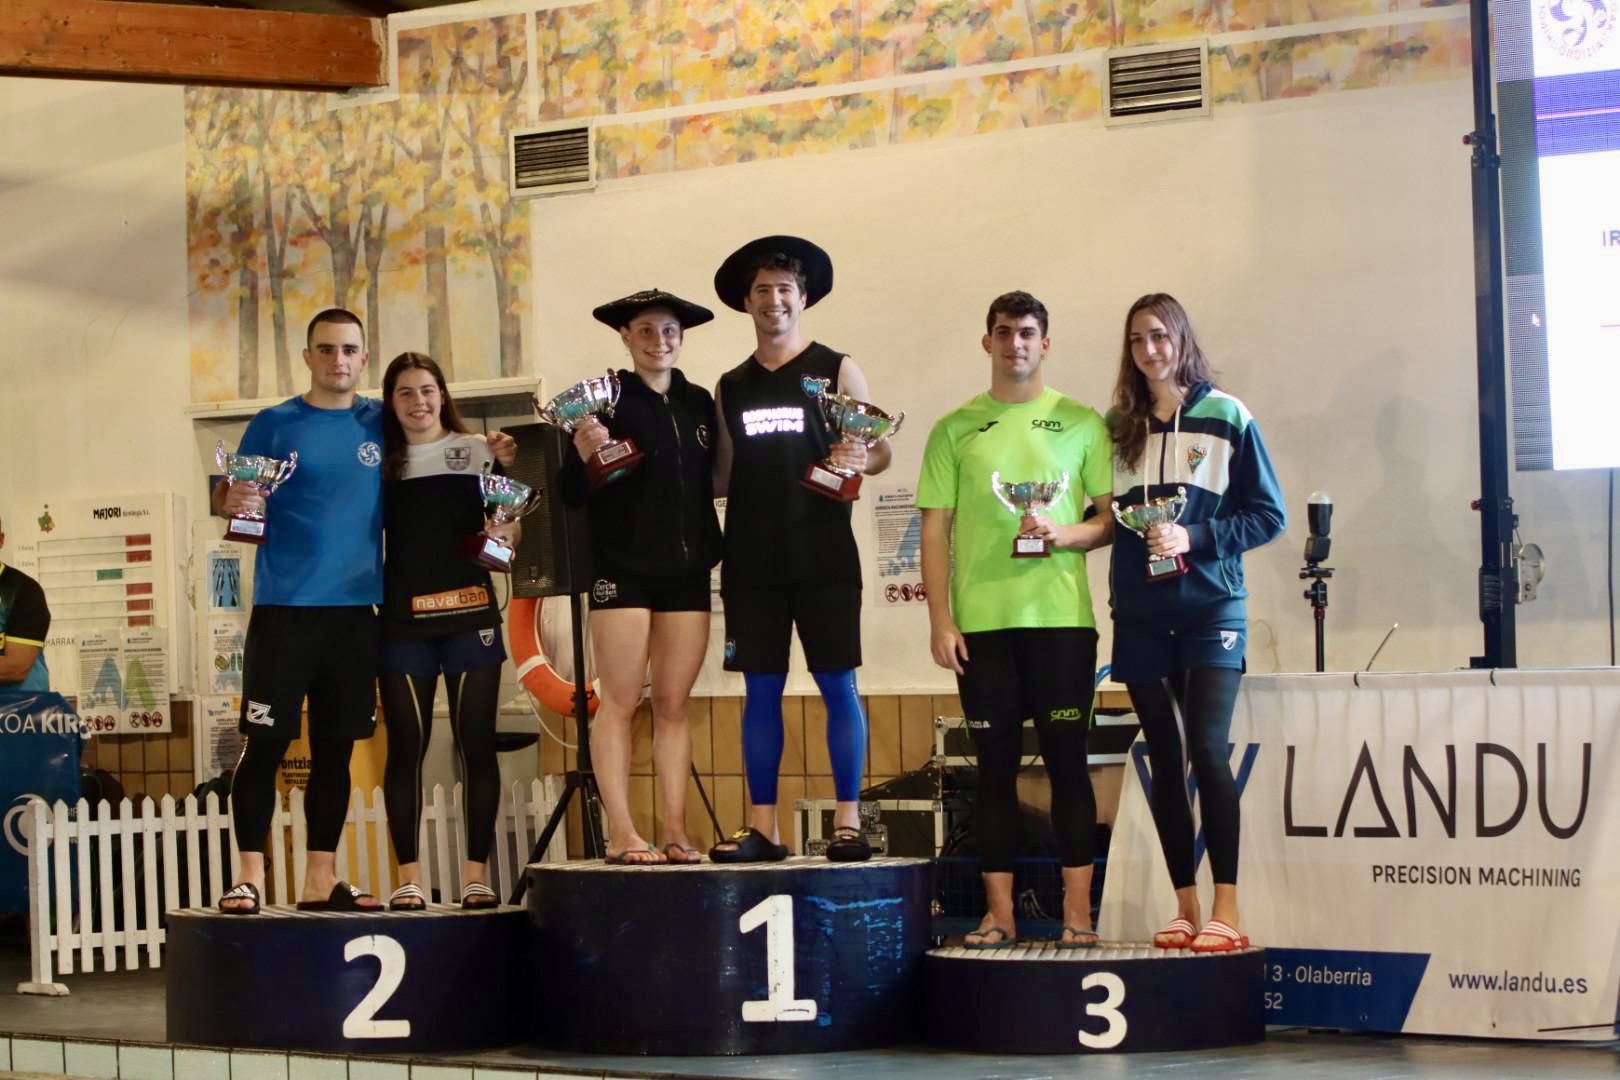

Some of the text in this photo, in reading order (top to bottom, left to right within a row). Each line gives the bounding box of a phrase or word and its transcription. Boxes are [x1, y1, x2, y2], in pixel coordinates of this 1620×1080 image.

[745, 419, 804, 436] SWIM
[93, 507, 121, 520] MAJORI
[415, 591, 487, 609] navarban
[1284, 740, 1592, 840] LANDU
[1372, 865, 1581, 887] PRECISION MACHINING
[739, 894, 818, 1023] 1
[343, 935, 411, 1039] 2
[1295, 965, 1372, 986] Olaberria
[1449, 969, 1588, 994] www.landu.es
[1078, 972, 1128, 1049] 3
